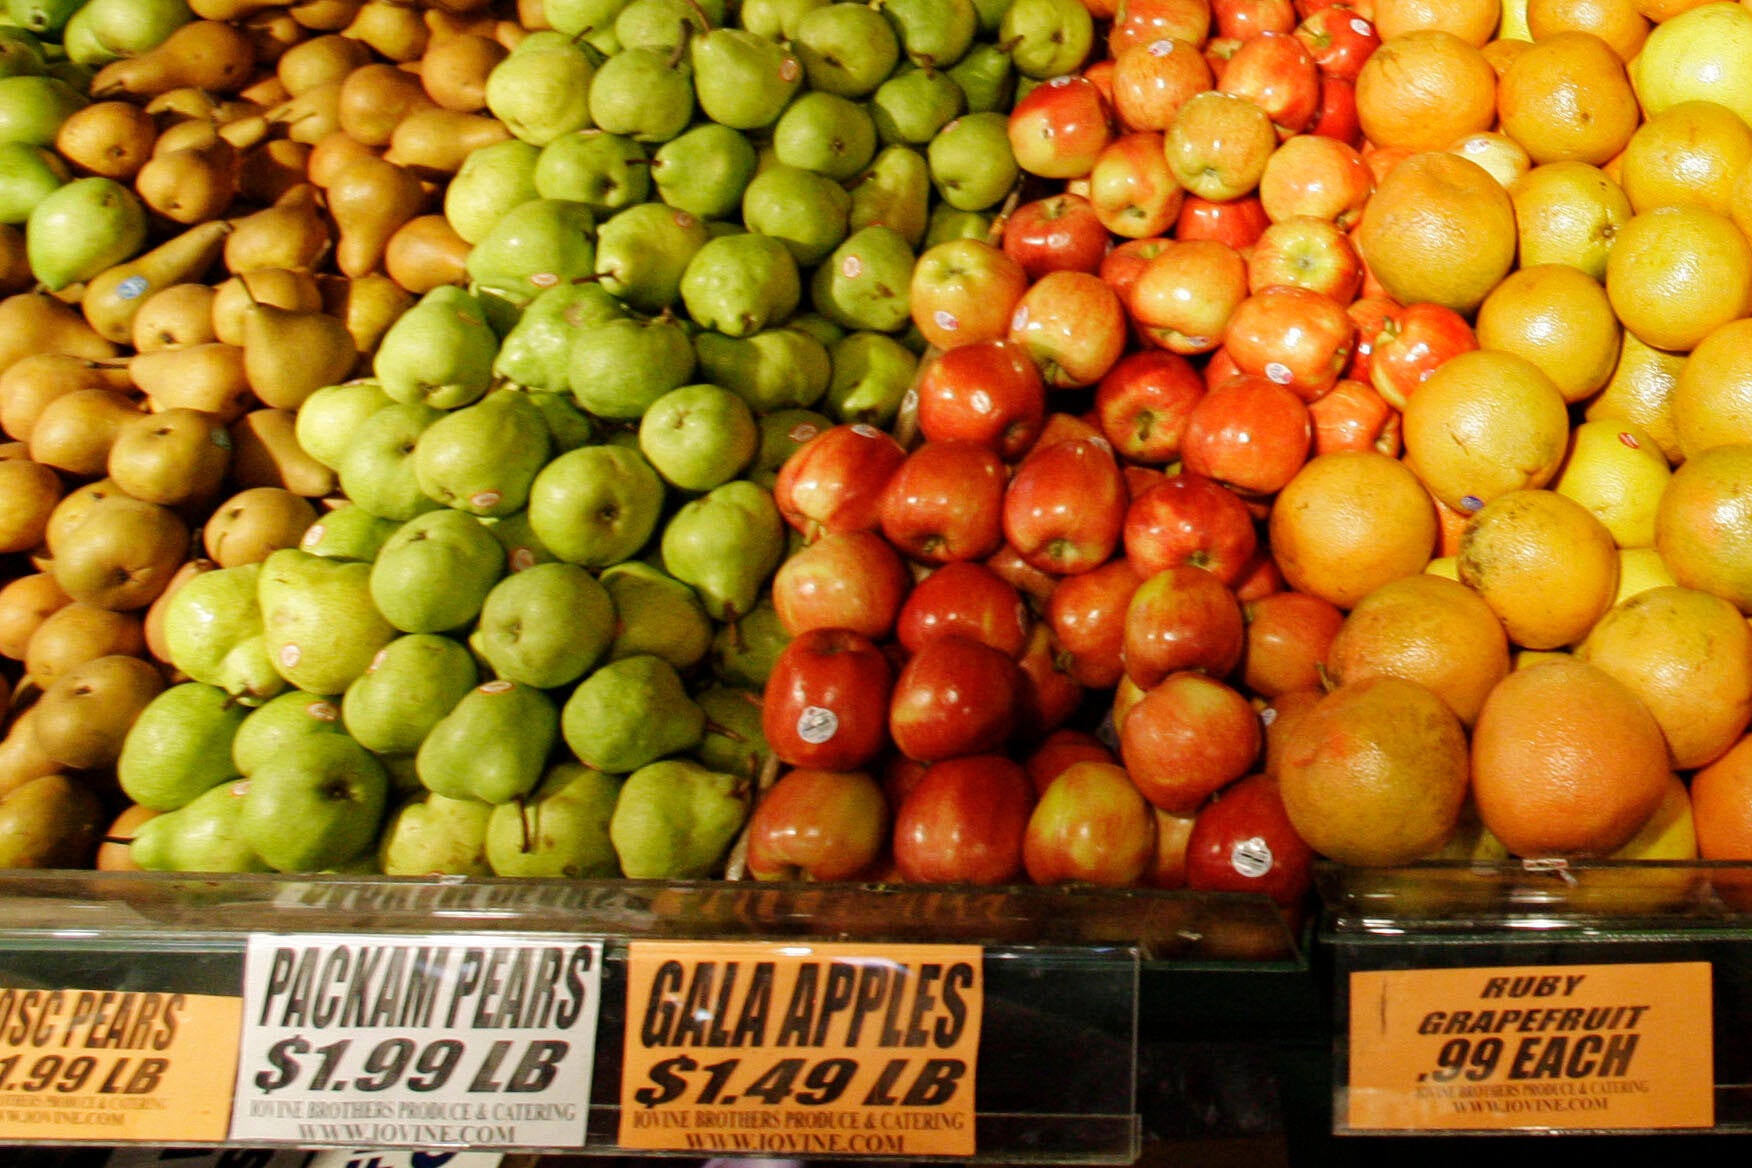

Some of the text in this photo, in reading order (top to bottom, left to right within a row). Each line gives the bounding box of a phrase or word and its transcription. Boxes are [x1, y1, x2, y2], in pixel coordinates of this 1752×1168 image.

[256, 941, 594, 1030] PACKAM PEARS
[641, 959, 974, 1050] GALA APPLES
[1480, 974, 1588, 999] RUBY
[0, 989, 187, 1050] OSC PEARS
[1417, 1005, 1650, 1036] GRAPEFRUIT
[0, 1053, 170, 1094] 1.99 LB
[254, 1034, 570, 1095] $1.99 LB
[634, 1054, 967, 1110] $1.49 LB
[1417, 1033, 1640, 1083] .99 EACH
[305, 1100, 395, 1120] BROTHERS
[397, 1101, 471, 1121] PRODUCE
[492, 1102, 577, 1122] CATERING
[694, 1110, 781, 1130] BROTHERS
[784, 1111, 860, 1131] PRODUCE
[880, 1111, 965, 1132] CATERING
